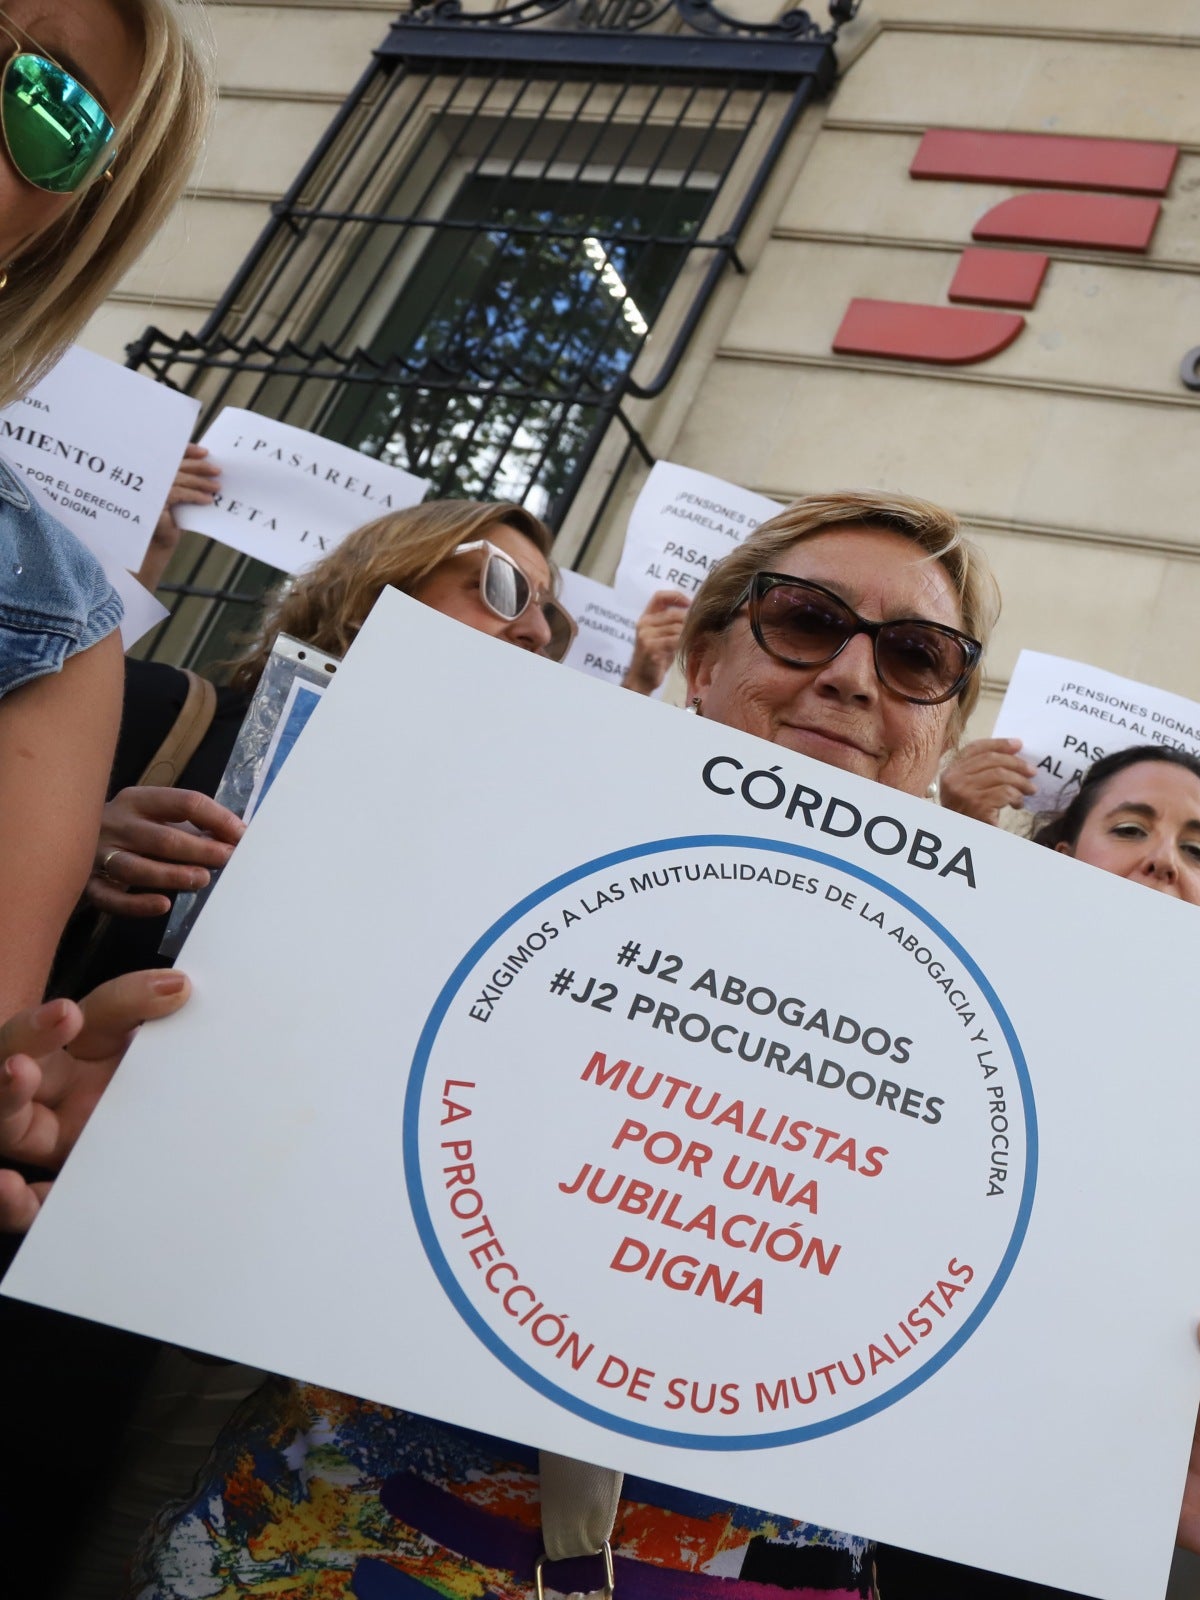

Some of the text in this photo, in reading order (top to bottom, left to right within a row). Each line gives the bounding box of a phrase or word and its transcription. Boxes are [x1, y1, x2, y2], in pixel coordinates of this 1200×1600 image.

[26, 467, 54, 486] POR
[56, 480, 71, 494] EL
[74, 487, 132, 520] DERECHO
[131, 514, 141, 525] A
[60, 496, 98, 520] DIGNA
[645, 562, 663, 581] AL
[1045, 694, 1128, 728] ¡PASARELA
[1129, 721, 1148, 738] AL
[1060, 682, 1148, 719] ¡PENSIONES
[1036, 754, 1065, 780] AL
[701, 755, 978, 890] CÓRDOBA
[468, 862, 1010, 1198] EXIGIMOS A LAS MUTUALIDADES DE LA ABOGACIA Y LA PROCURA
[548, 966, 946, 1126] #J2 PROCURADORES
[615, 939, 914, 1065] #J2 ABOGADOS
[579, 1050, 890, 1179] MUTUALISTAS
[610, 1117, 819, 1216] POR UNA
[440, 1078, 975, 1416] LA PROTECCIÓN DE SUS MUTUALISTAS
[557, 1162, 843, 1277] JUBILACIÓN
[608, 1235, 764, 1316] DIGNA
